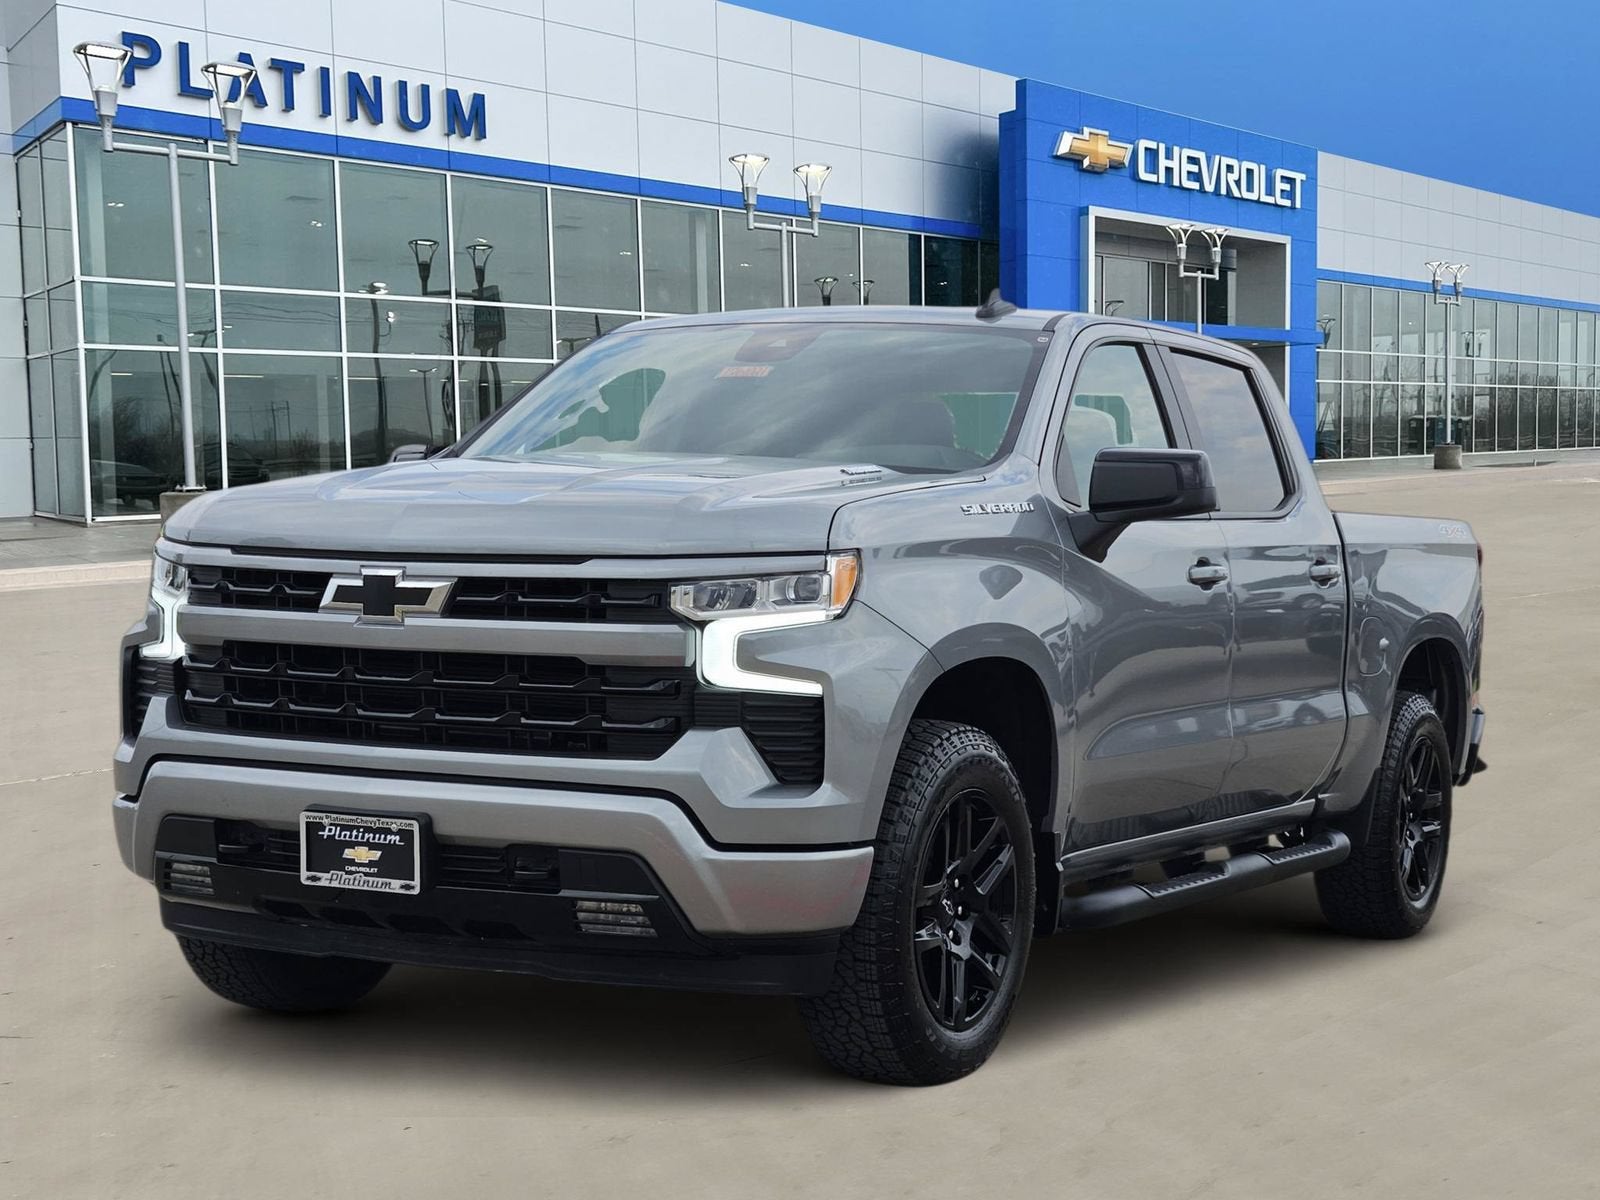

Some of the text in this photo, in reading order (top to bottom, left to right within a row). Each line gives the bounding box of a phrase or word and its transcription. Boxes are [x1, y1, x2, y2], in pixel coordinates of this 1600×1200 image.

[121, 31, 486, 140] PLATINUM
[1136, 139, 1306, 209] CHEVROLET
[318, 825, 405, 845] Platinum
[345, 865, 378, 873] CHEVROLET
[324, 872, 397, 890] Platinum
